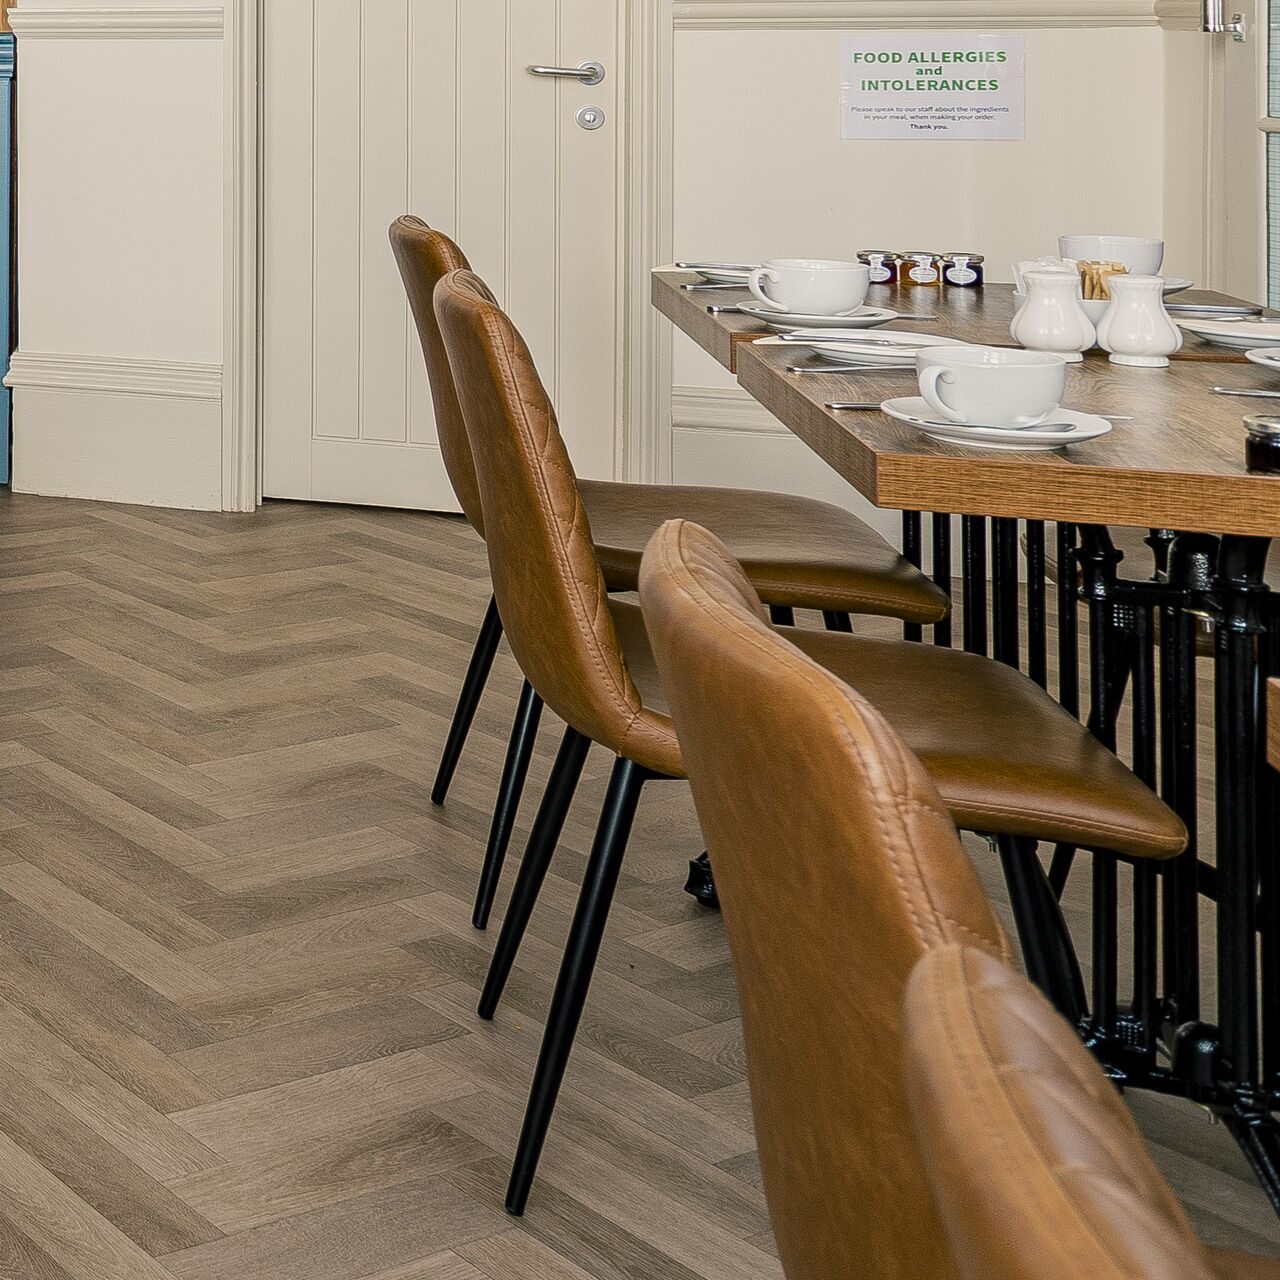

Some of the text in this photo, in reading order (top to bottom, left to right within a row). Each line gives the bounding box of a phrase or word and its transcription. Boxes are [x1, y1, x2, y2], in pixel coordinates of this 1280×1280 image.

[853, 51, 1007, 64] FOOD ALLERGIES
[915, 66, 943, 76] and
[861, 79, 1000, 92] INTOLERANCES
[874, 106, 895, 114] speak
[969, 106, 1009, 115] ingredients
[889, 114, 908, 122] meal,
[930, 114, 956, 122] making
